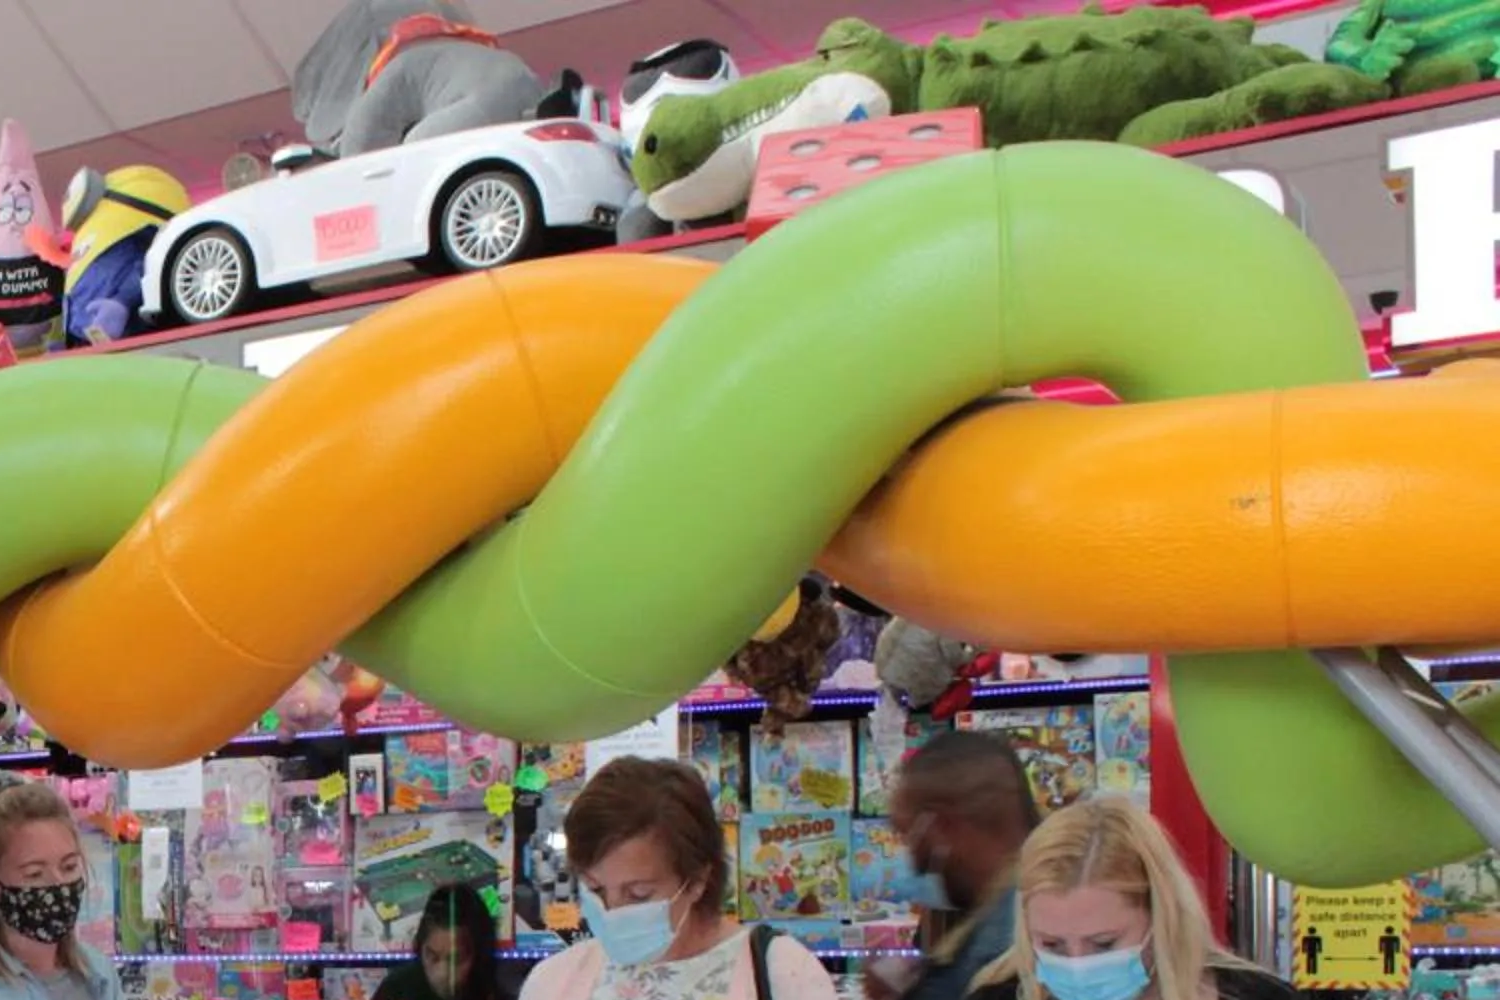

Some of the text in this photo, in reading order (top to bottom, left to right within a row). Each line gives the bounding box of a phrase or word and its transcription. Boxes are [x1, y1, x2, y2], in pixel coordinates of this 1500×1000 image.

[5, 266, 39, 281] WITH
[1, 277, 49, 293] DUMMY
[1305, 895, 1349, 906] Please
[1352, 895, 1385, 907] keep
[1309, 911, 1397, 921] safe distance
[1333, 927, 1367, 938] apart
